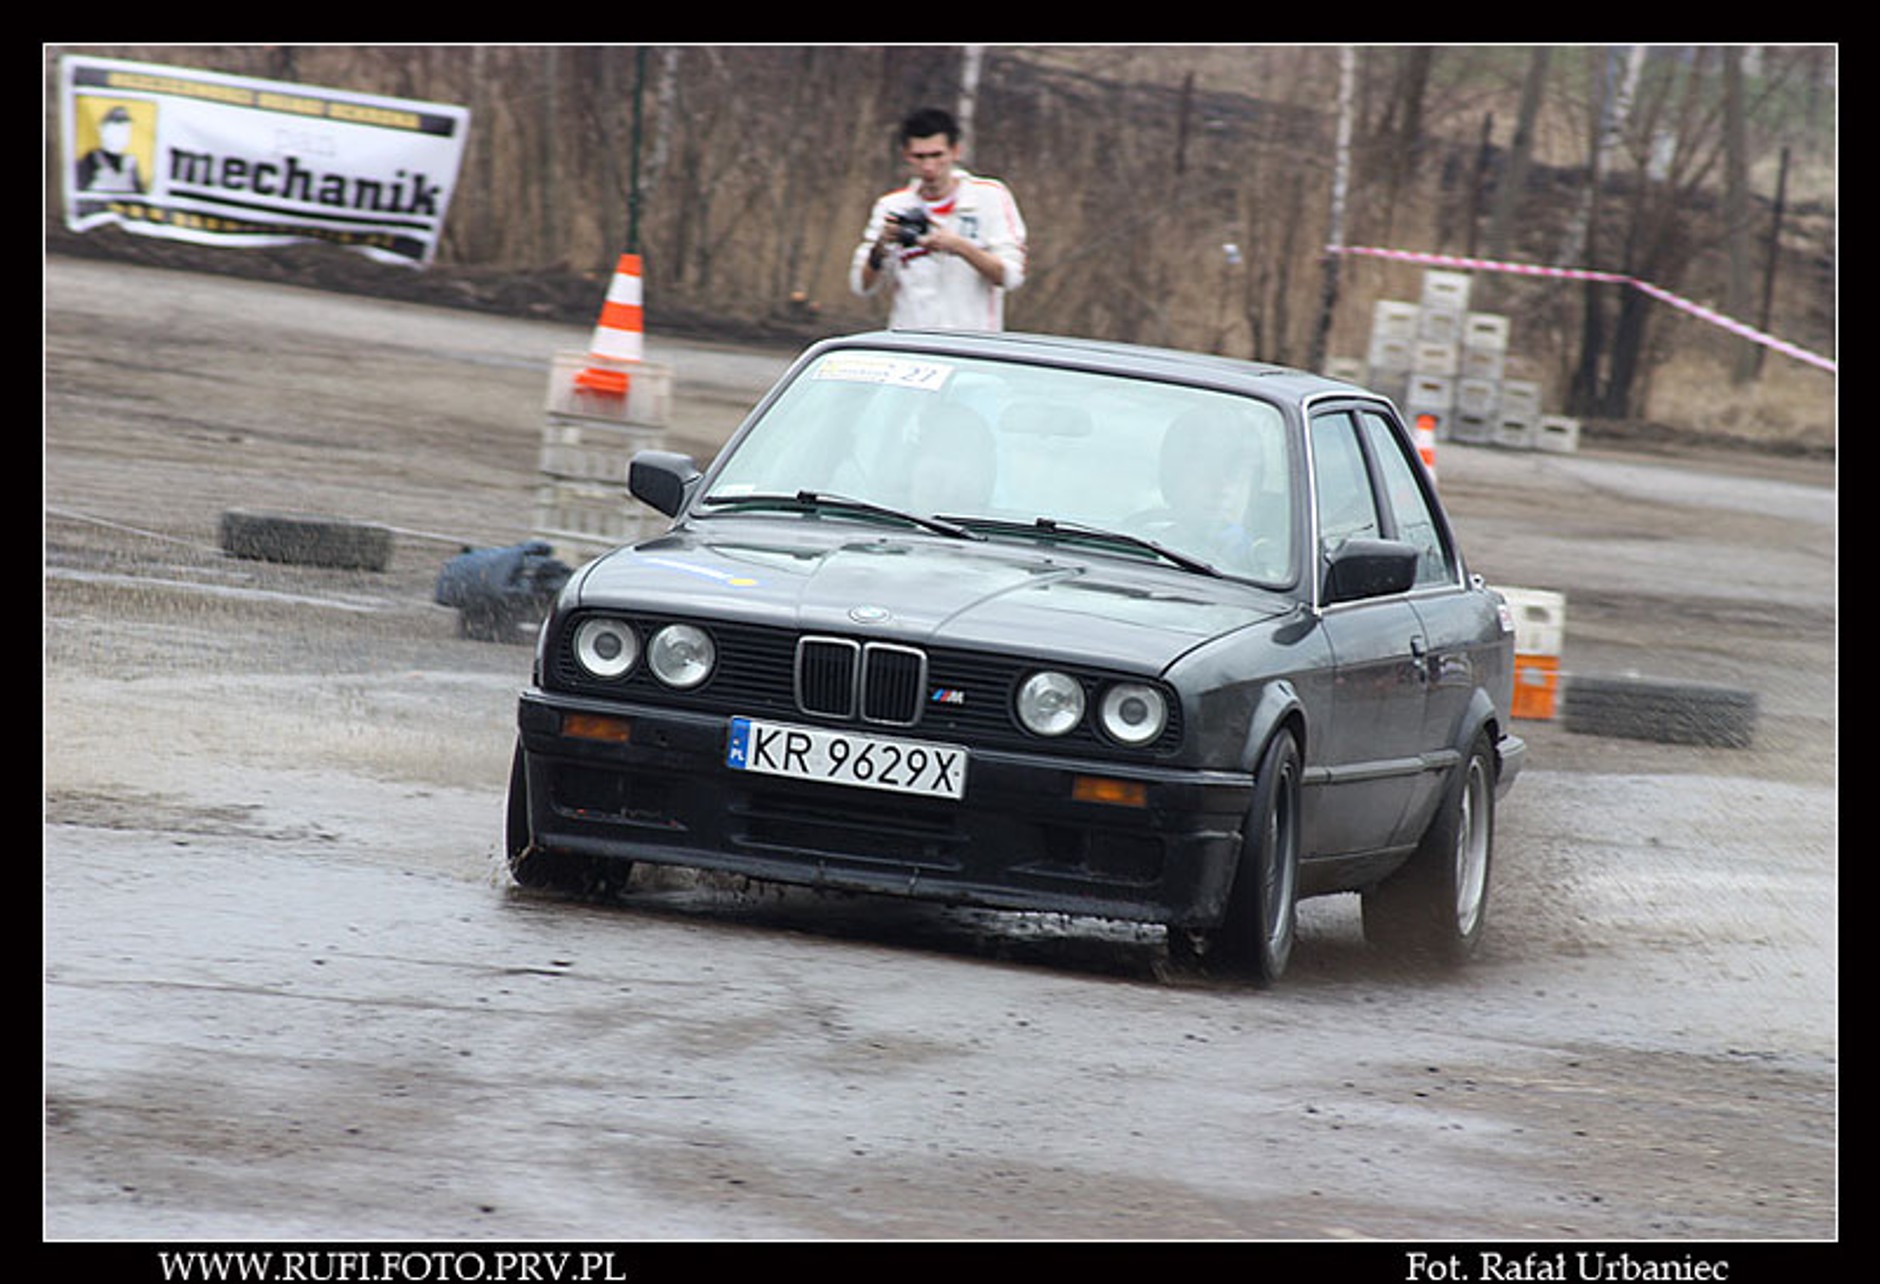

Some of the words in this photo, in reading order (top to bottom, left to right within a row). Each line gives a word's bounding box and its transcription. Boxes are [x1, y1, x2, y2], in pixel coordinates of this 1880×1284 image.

[168, 146, 442, 216] mechanik
[753, 728, 812, 773] KR
[827, 738, 957, 792] 9629X
